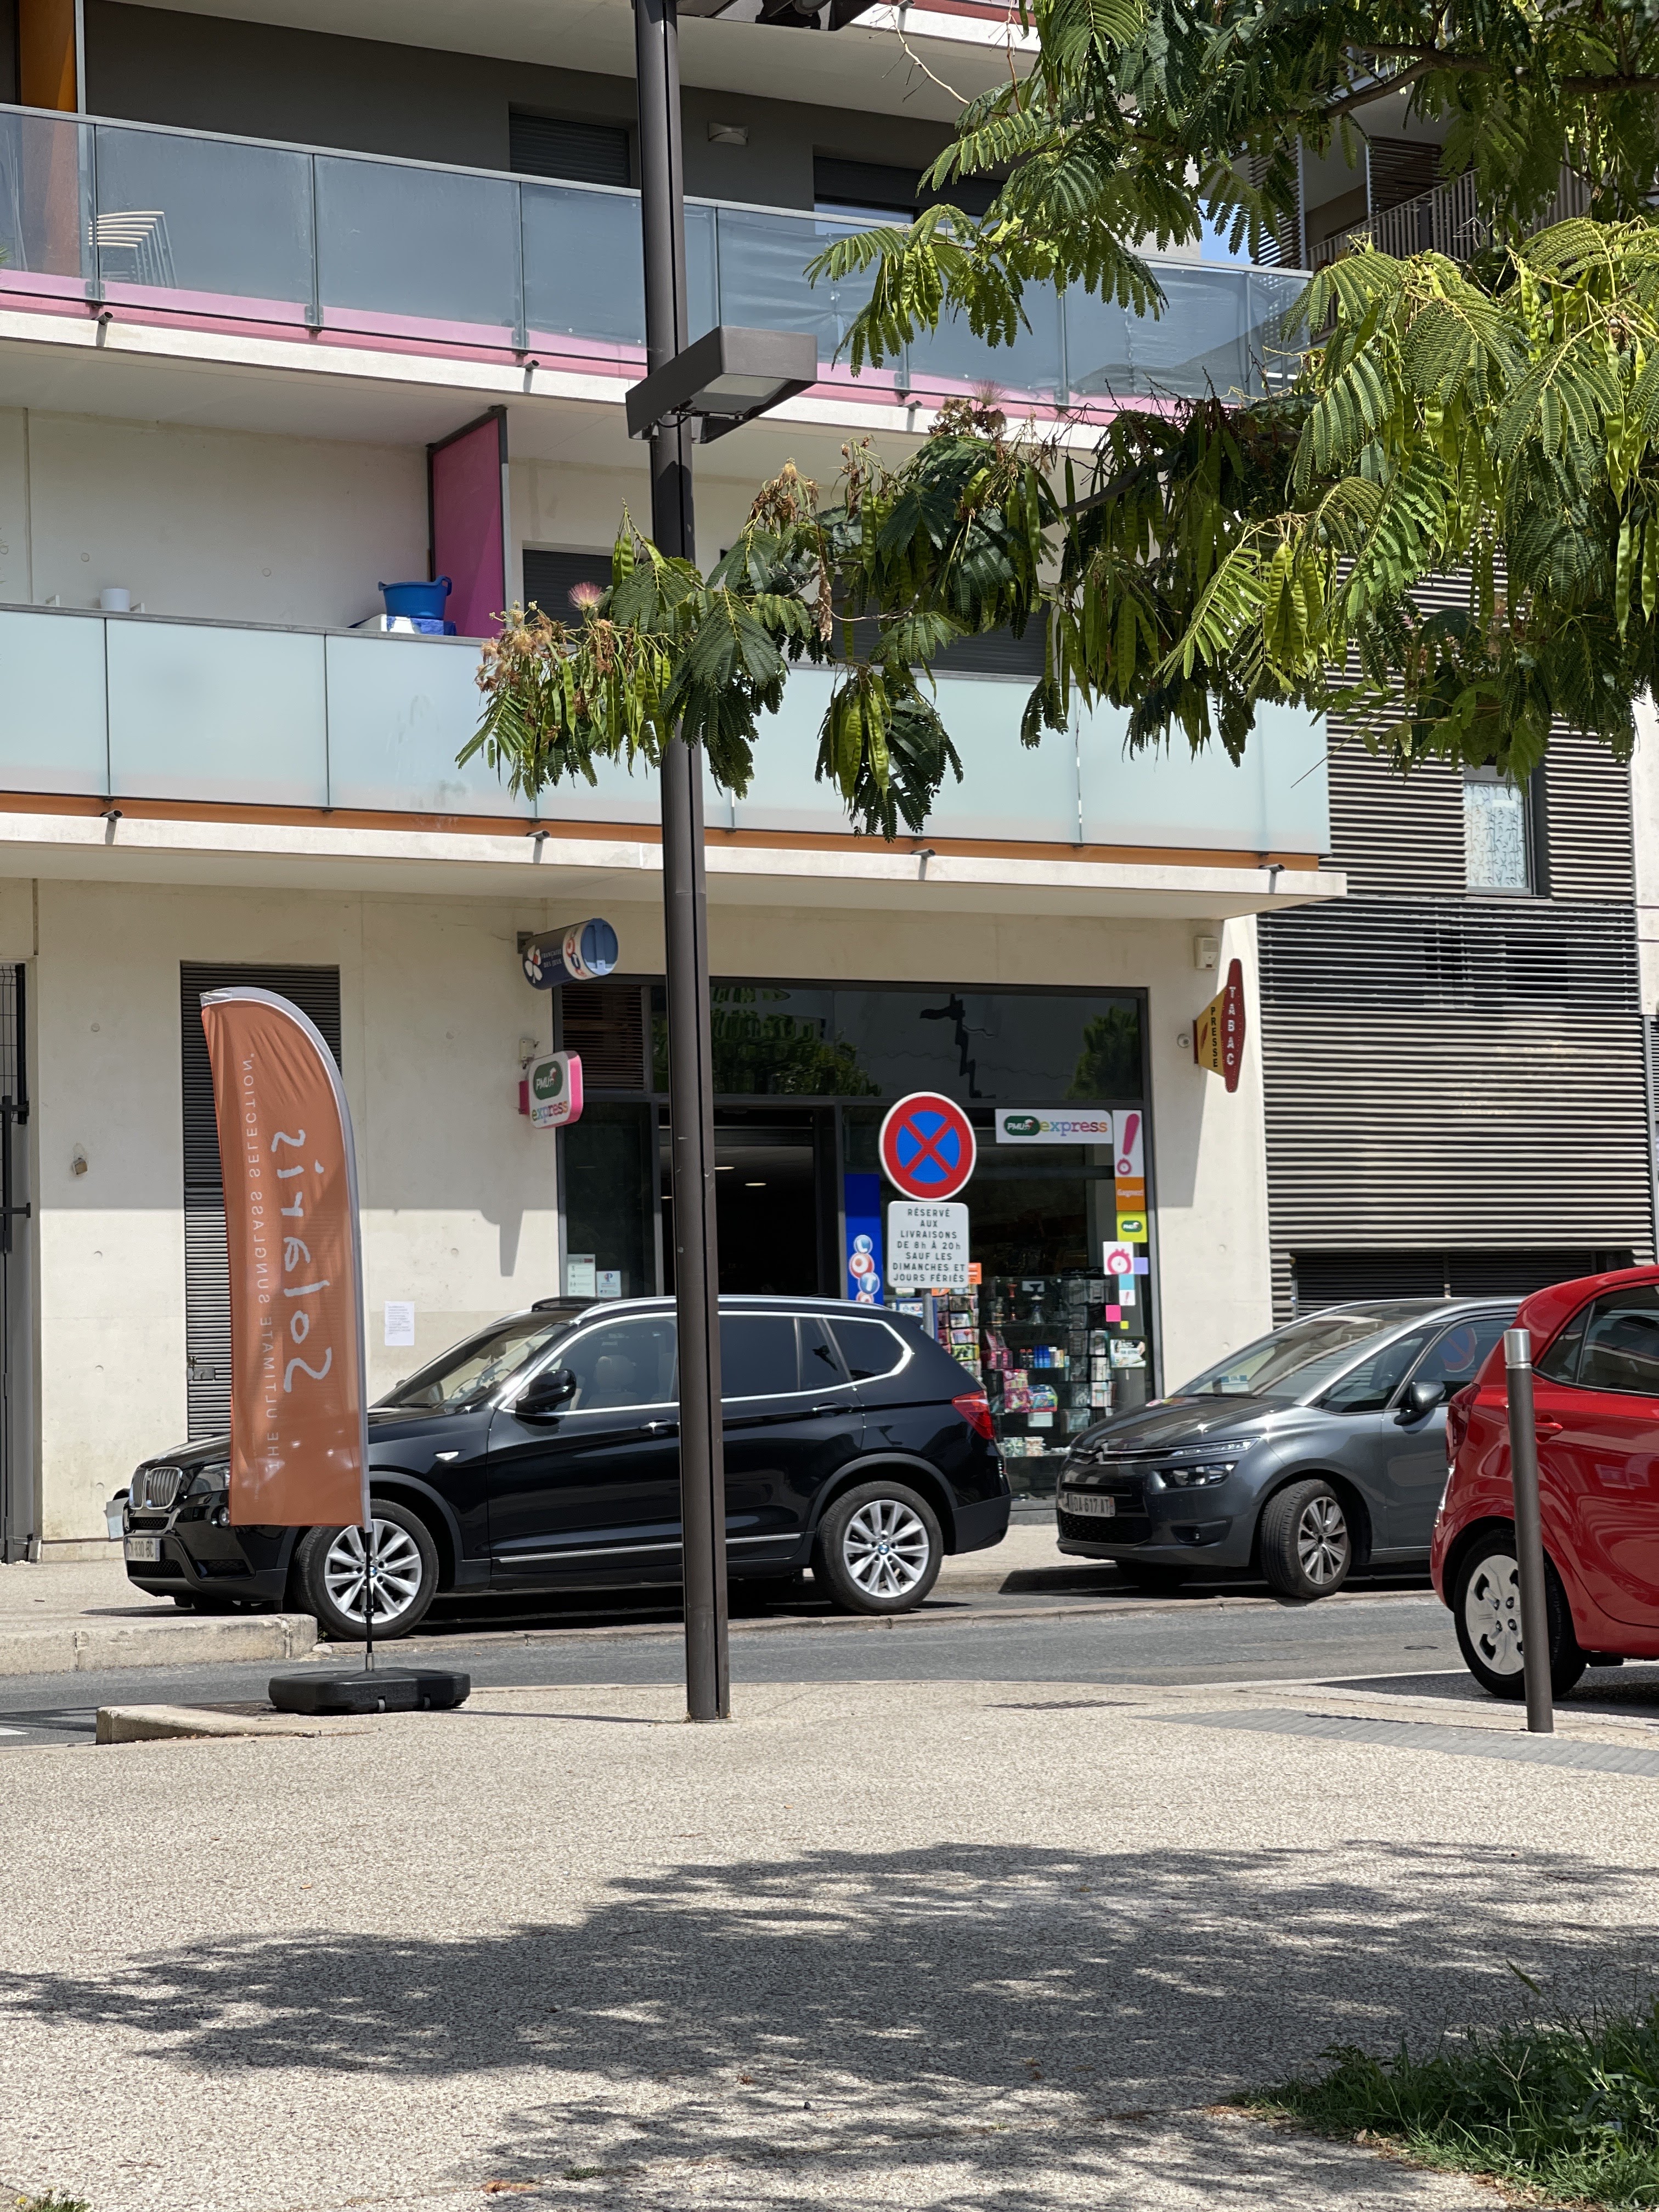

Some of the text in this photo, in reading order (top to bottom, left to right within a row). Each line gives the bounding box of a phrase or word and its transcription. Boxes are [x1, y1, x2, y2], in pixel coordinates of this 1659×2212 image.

[1227, 986, 1236, 1065] TABAC
[535, 1076, 550, 1091] PMU
[532, 1101, 568, 1124] express
[1040, 1121, 1108, 1136] express
[907, 1207, 950, 1217] RÉSERVÉ
[920, 1220, 938, 1228] AUX
[901, 1230, 957, 1239] LIVRAISONS
[893, 1262, 949, 1271] DIMANCHES
[893, 1273, 926, 1282] JOURS
[930, 1272, 964, 1282] FÉRIÉS
